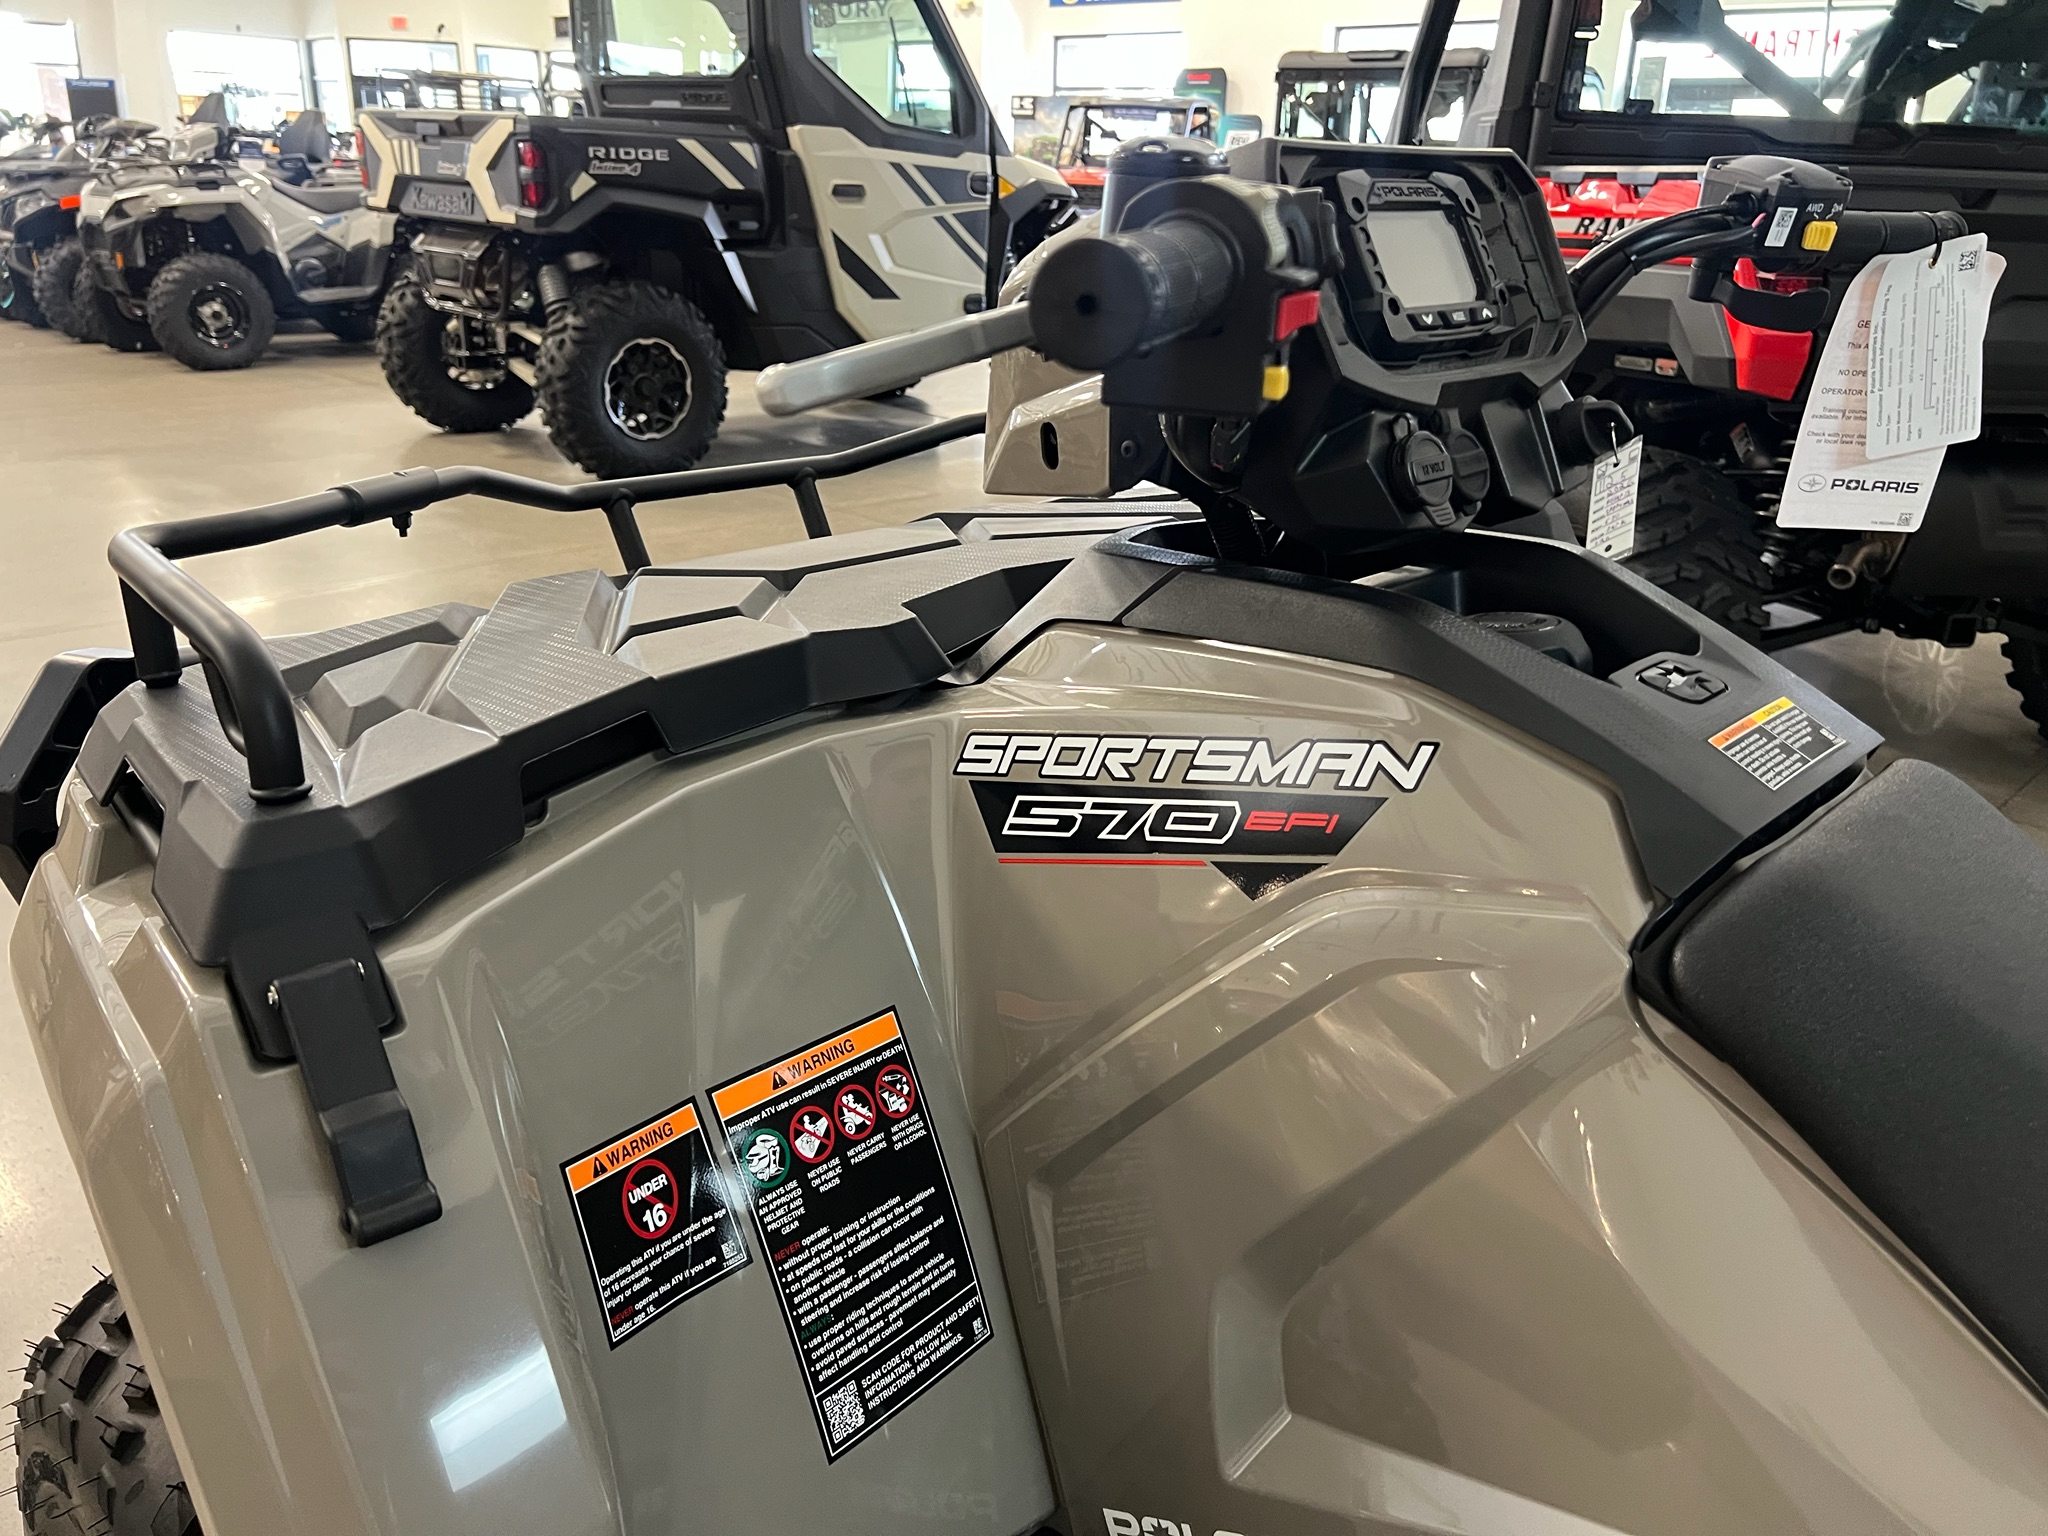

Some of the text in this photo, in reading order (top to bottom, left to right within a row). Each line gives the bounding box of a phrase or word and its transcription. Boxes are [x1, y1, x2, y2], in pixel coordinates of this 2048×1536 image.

[587, 145, 670, 161] RIDGE
[413, 185, 475, 216] Kawasaki
[1380, 186, 1440, 199] POLARIS
[1805, 202, 1824, 213] AWD
[1838, 369, 1850, 377] NO
[1821, 387, 1864, 397] OPERATOR
[1830, 478, 1919, 494] POLARIS
[954, 732, 1439, 791] SPORTSMAN
[1002, 795, 1340, 844] 570 EFI
[787, 1038, 855, 1080] WARNING
[727, 1043, 903, 1134] Improper ATV use can result SEVERE INJURY DEATH
[890, 1112, 919, 1133] NEVER USE
[891, 1120, 923, 1141] WITH DRUGS
[903, 1128, 927, 1146] ALCOHOL
[606, 1121, 674, 1167] WARNING
[846, 1131, 884, 1157] NEVER CARRY
[850, 1140, 887, 1165] PASSENGERS
[807, 1156, 840, 1179] NEVER USE
[820, 1165, 842, 1181] PUBLIC
[627, 1173, 668, 1205] UNDER
[758, 1179, 798, 1205] ALWAYS USE
[769, 1187, 802, 1210] APPROVED
[819, 1176, 840, 1192] ROADS
[642, 1202, 667, 1232] 16
[763, 1197, 802, 1223] HELMET AND
[766, 1206, 805, 1232] PROTECTIVE
[781, 1220, 799, 1234] GEAR
[782, 1195, 900, 1269] without proper training instruction
[794, 1256, 820, 1276] speeds
[820, 1249, 832, 1260] too
[832, 1239, 846, 1253] fast
[846, 1234, 856, 1244] for
[856, 1225, 870, 1240] your
[893, 1205, 904, 1215] the
[904, 1186, 935, 1209] conditions
[801, 1225, 830, 1246] operate:
[600, 1207, 726, 1286] Operating this ATV you are under the age
[619, 1225, 715, 1287] increases your chance severe
[774, 1241, 801, 1262] NEVER
[800, 1205, 923, 1287] public roads collision can occur with
[796, 1215, 944, 1314] with passenger passengers affect balance and
[606, 1276, 652, 1308] injury death.
[634, 1290, 658, 1310] operate
[658, 1282, 671, 1293] this
[671, 1272, 683, 1286] ATV
[689, 1262, 704, 1276] you
[704, 1256, 716, 1266] are
[793, 1267, 845, 1304] another vehicle
[800, 1236, 929, 1326] steering and increase risk losing control
[808, 1252, 944, 1348] use proper riding techniques avoid vehicle
[811, 1333, 844, 1359] overturns
[854, 1316, 869, 1330] hills
[869, 1306, 882, 1320] and
[882, 1294, 901, 1311] rough
[901, 1281, 921, 1298] terrain
[921, 1271, 933, 1284] and
[613, 1304, 657, 1336] under age 16.
[799, 1314, 835, 1341] ALWAYS:
[815, 1268, 956, 1372] avoid paved surfaces pavement may seriously
[818, 1317, 903, 1381] affect handling and control
[861, 1294, 979, 1388] SCAN CODE FOR PRODUCT AND SAFETY
[864, 1360, 912, 1399] INFORMATION.
[913, 1337, 939, 1362] FOLLOW
[940, 1329, 952, 1342] ALL
[867, 1368, 916, 1410] INSTRUCTIONS
[916, 1358, 930, 1373] AND
[929, 1333, 963, 1362] WARNINGS.
